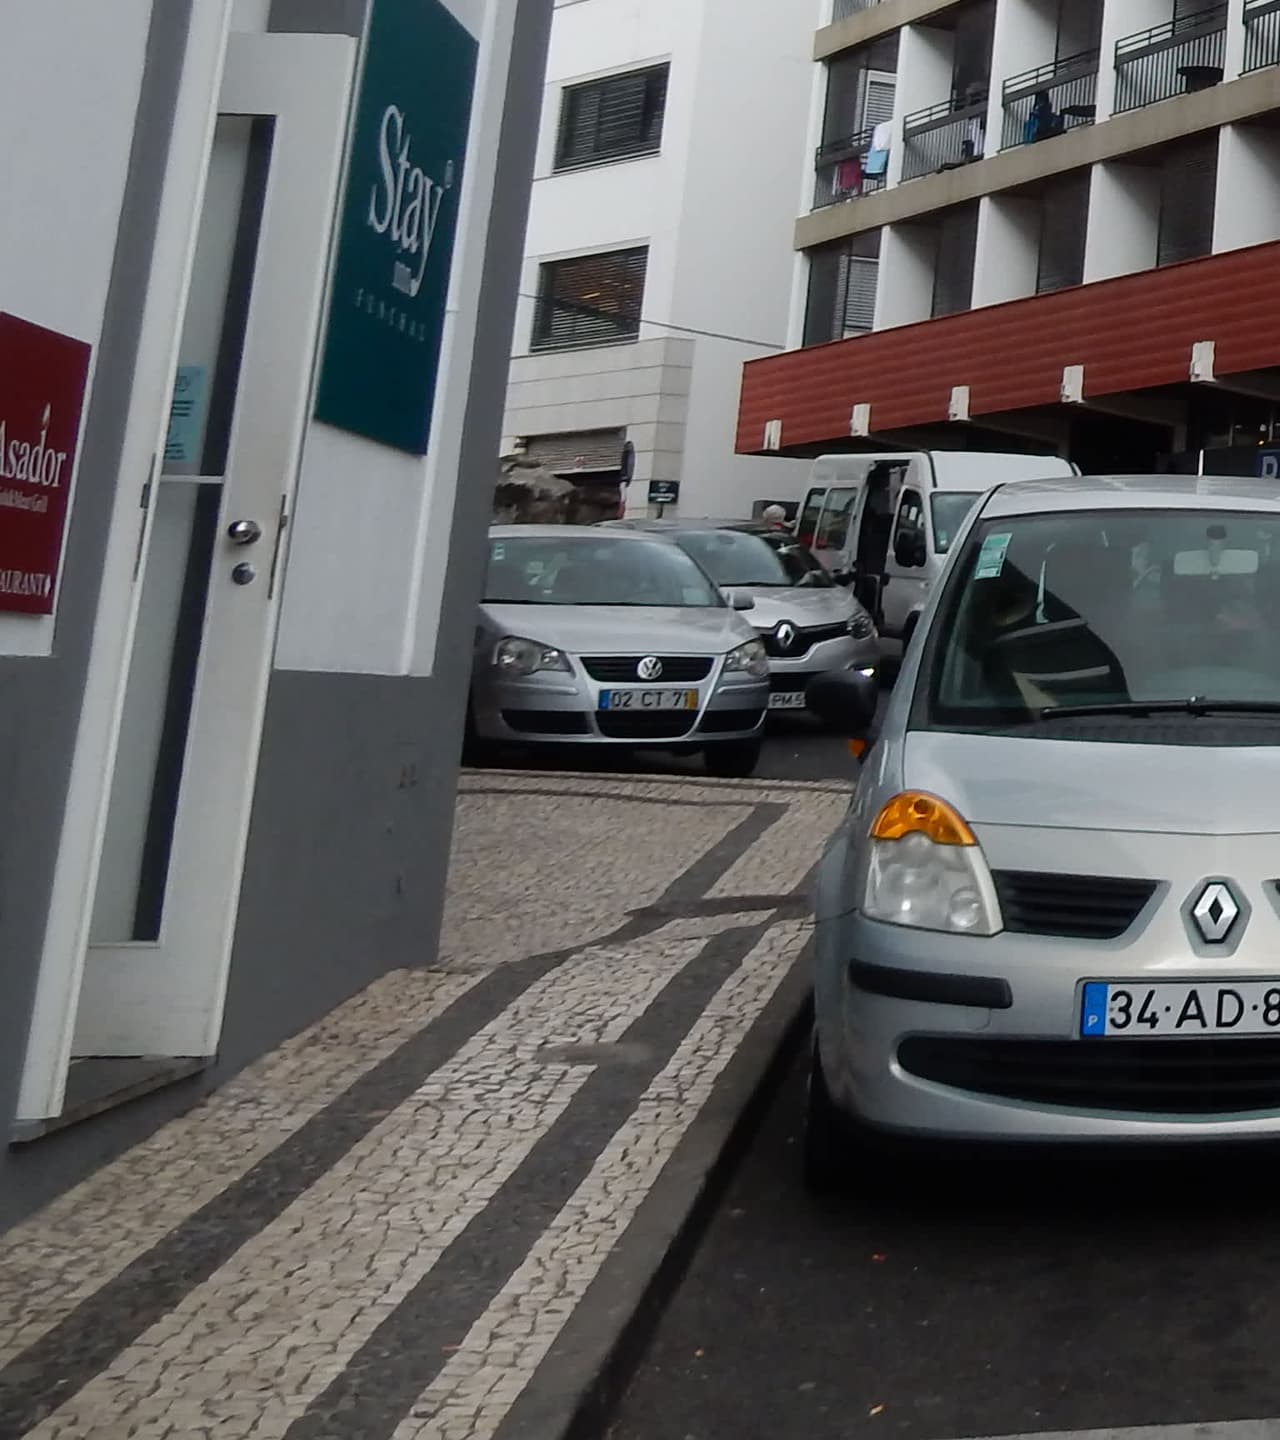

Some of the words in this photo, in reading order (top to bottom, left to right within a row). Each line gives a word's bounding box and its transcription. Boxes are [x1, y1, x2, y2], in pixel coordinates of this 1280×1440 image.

[368, 104, 443, 298] Stay
[0, 568, 45, 596] AURANT
[611, 691, 632, 708] 02
[641, 691, 663, 707] CT
